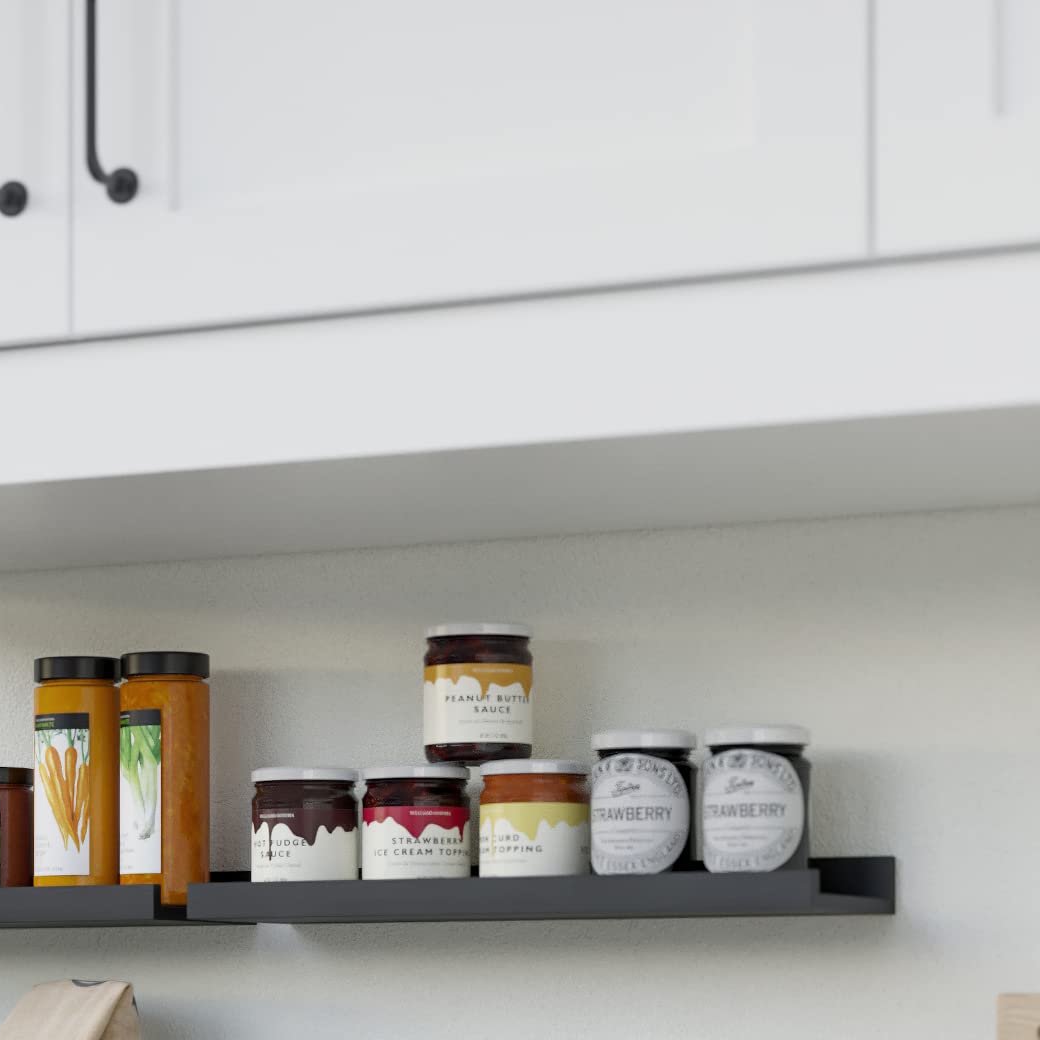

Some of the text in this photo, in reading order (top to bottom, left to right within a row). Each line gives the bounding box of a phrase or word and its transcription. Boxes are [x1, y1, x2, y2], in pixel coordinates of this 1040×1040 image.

[445, 694, 529, 704] PEANUT BUTTE
[473, 706, 511, 714] SAUCE
[705, 803, 786, 819] TRAWBERRY
[374, 849, 388, 857] ICE
[393, 848, 433, 856] CREAM
